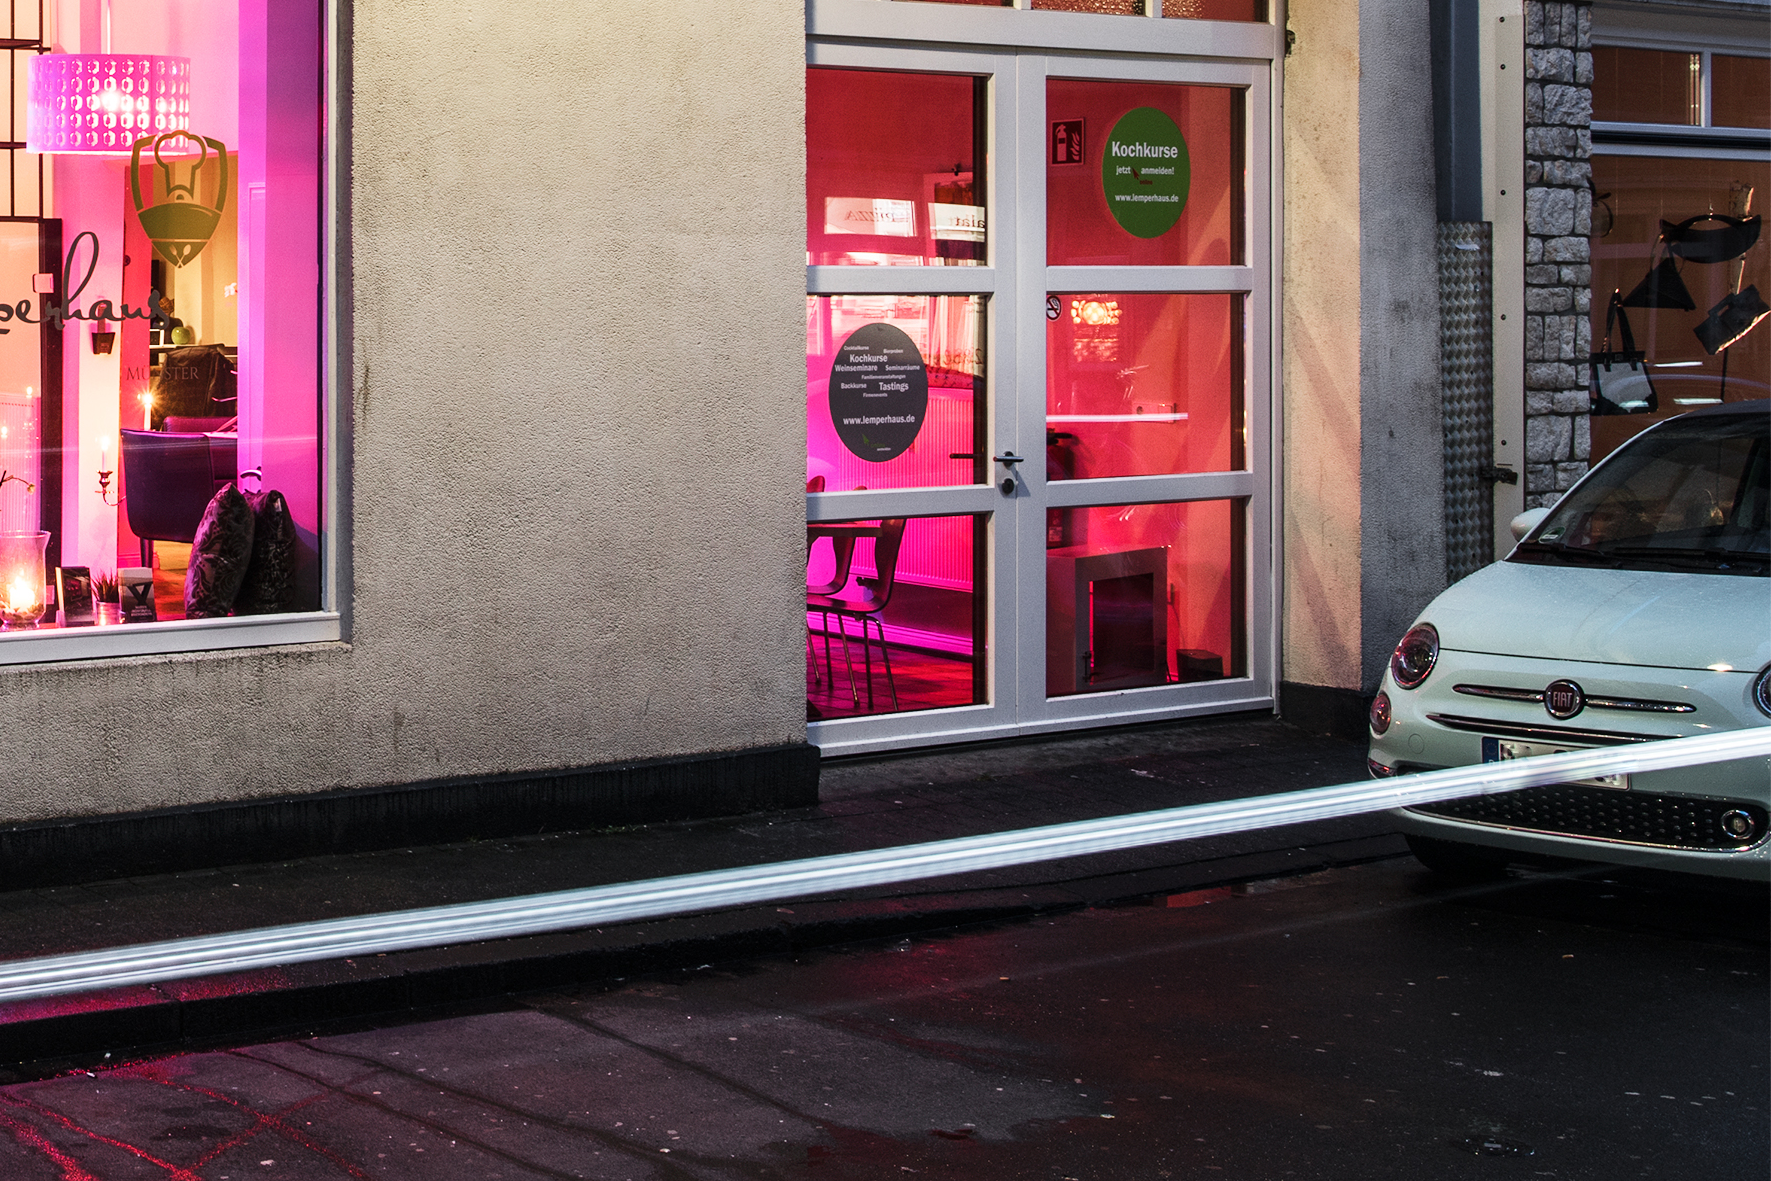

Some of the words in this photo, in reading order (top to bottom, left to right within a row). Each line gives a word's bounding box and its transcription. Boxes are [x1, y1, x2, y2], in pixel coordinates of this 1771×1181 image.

[1112, 141, 1178, 158] Kochkurse
[1116, 165, 1131, 175] jetzt
[1141, 167, 1175, 175] anmelden!
[1115, 193, 1179, 203] www.lemperhaus.de
[850, 353, 888, 363] Kochkurse
[834, 364, 878, 372] Weinseminare
[878, 381, 909, 392] Tastings
[843, 414, 916, 425] www.lemperhaus.de
[1553, 691, 1573, 708] FIAT
